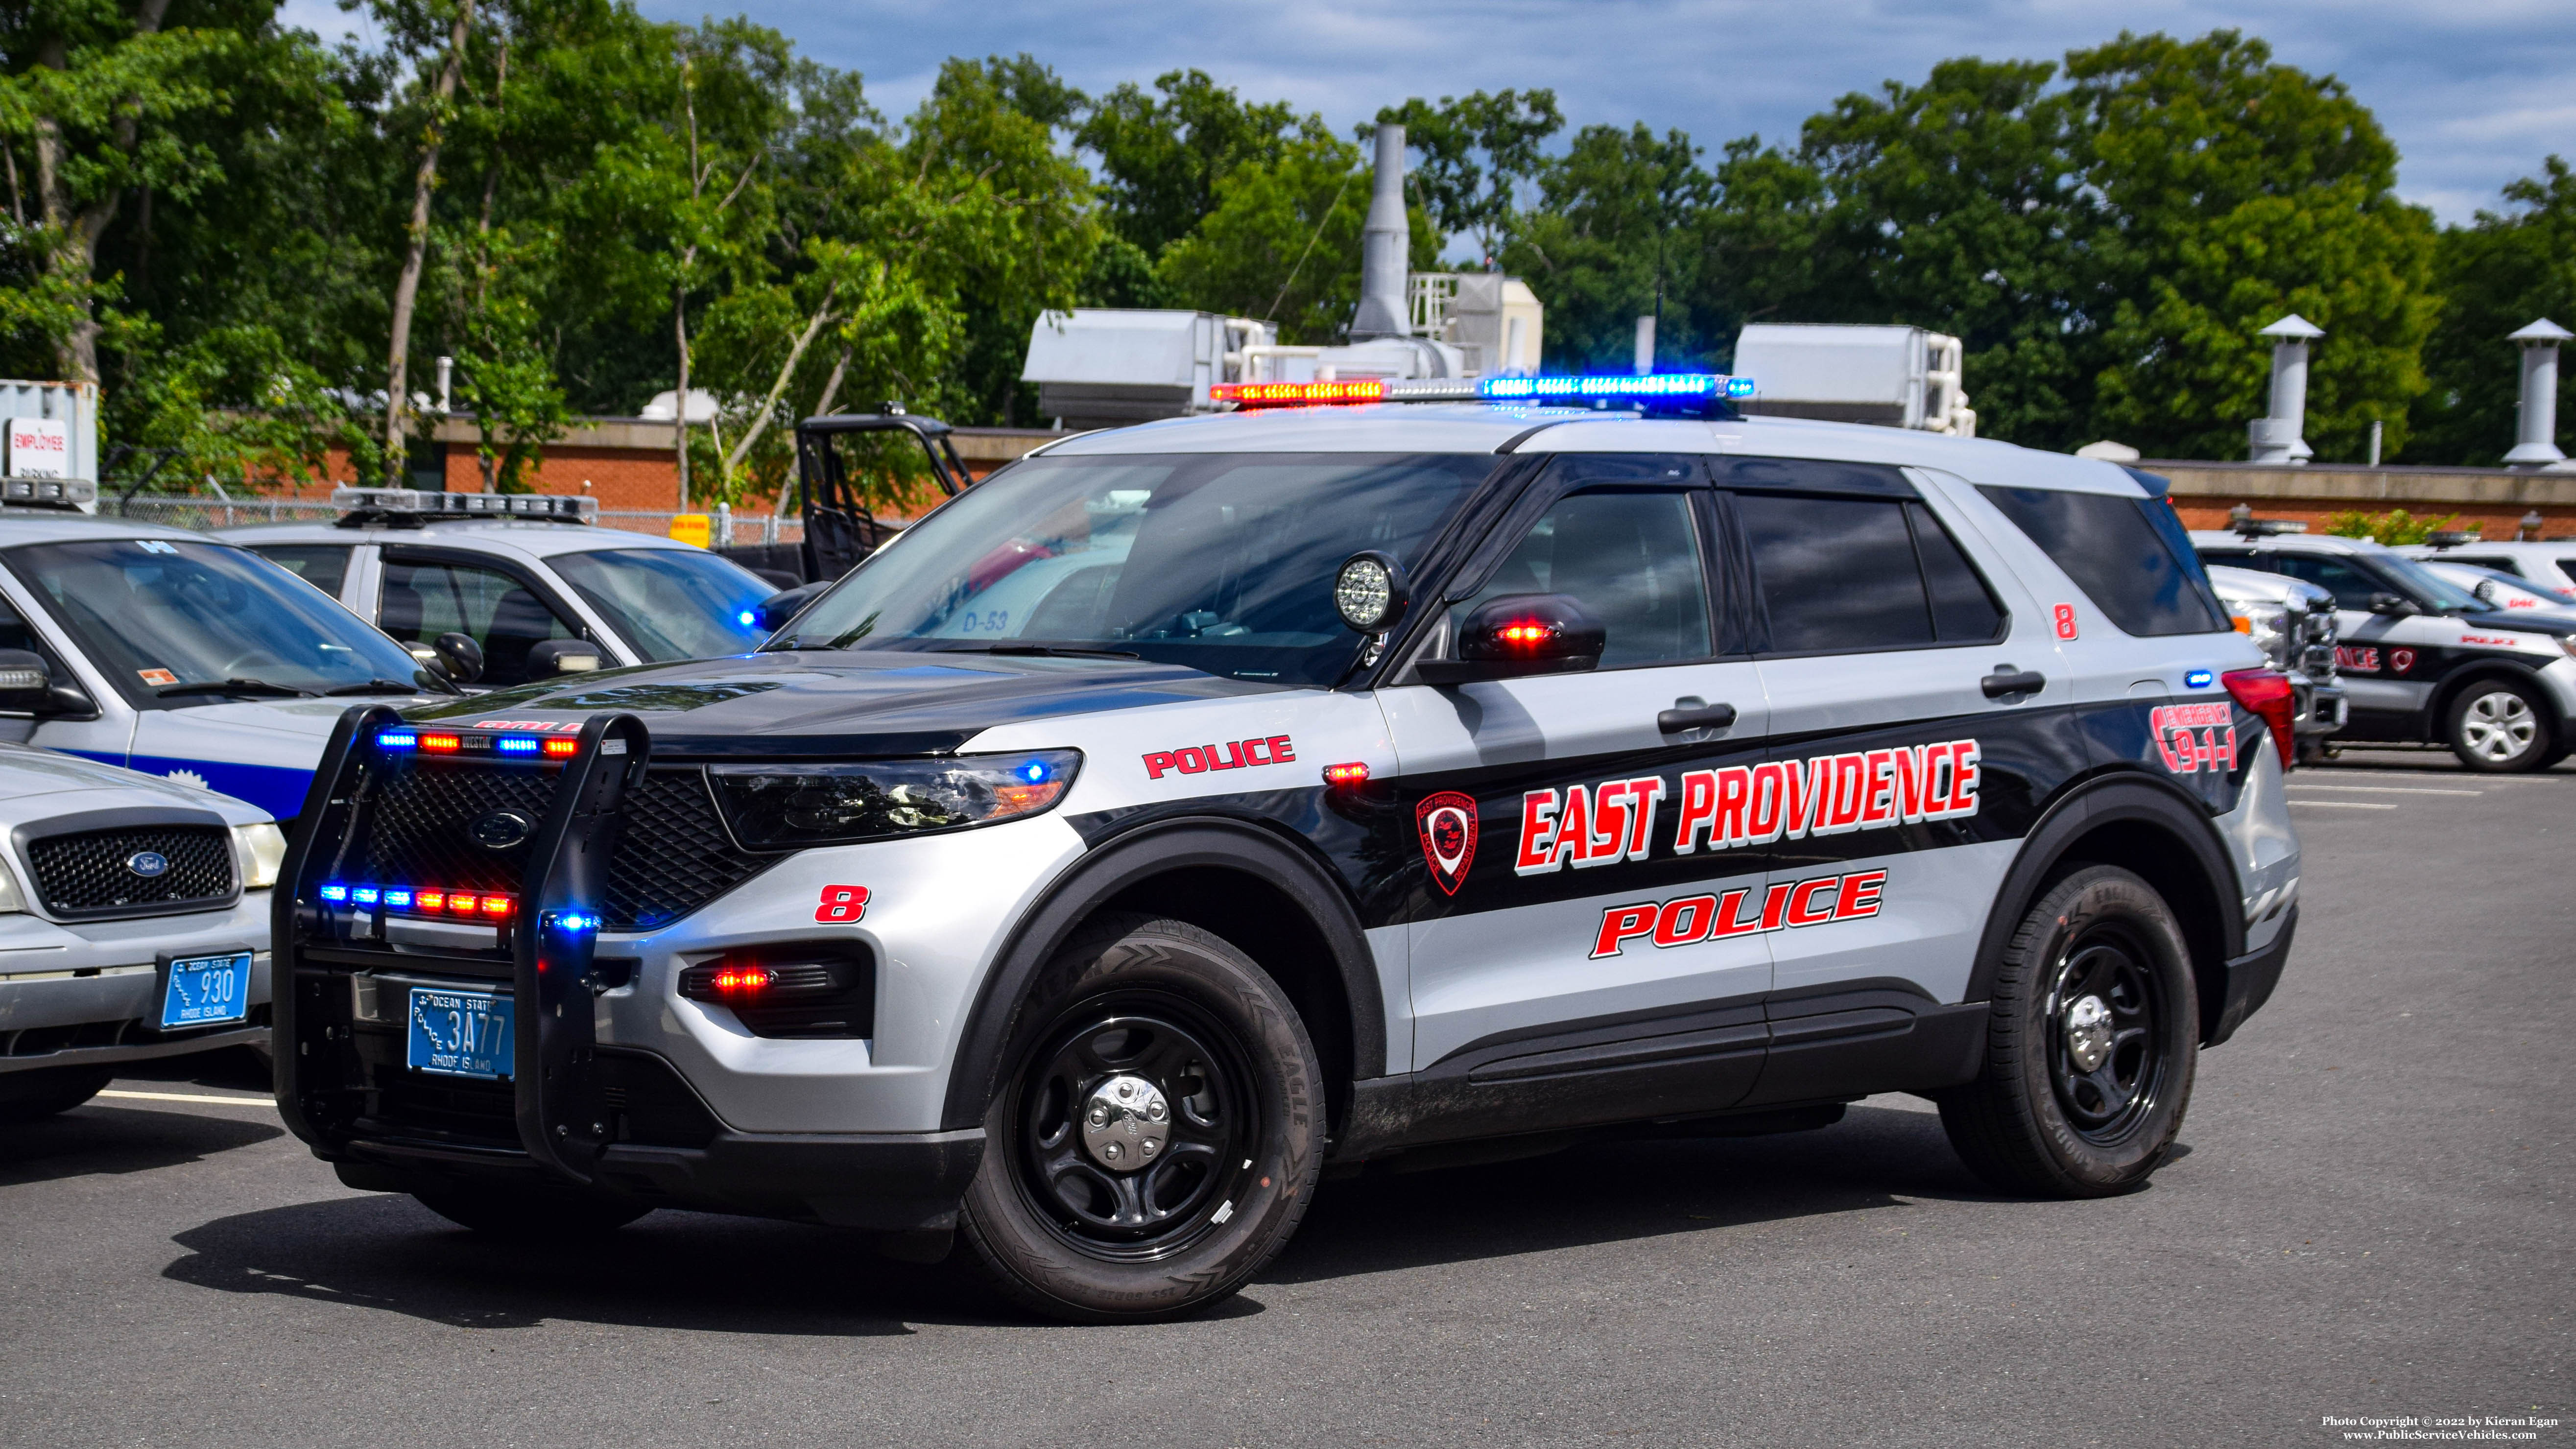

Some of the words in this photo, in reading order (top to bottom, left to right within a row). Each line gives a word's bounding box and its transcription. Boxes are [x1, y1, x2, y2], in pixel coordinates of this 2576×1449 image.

[15, 433, 65, 451] EMPLOYEE
[963, 610, 1009, 632] D-53
[2052, 602, 2079, 641] 8
[2163, 701, 2233, 730] EMERGENCY
[1142, 735, 1296, 780] POLICE
[2173, 725, 2238, 773] 9-1-1
[1419, 800, 1433, 819] EAST
[1435, 795, 1475, 813] PROVIDENCE
[1514, 776, 1665, 877] EAST
[1673, 738, 1981, 855] PROVIDENCE
[1423, 833, 1441, 874] POLICE
[1454, 817, 1476, 881] DEPARTMENT
[813, 883, 872, 925] 8
[1588, 868, 1888, 960] POLICE
[188, 961, 209, 971] OCEAN
[211, 958, 232, 969] STATE
[201, 969, 234, 1003] 930
[433, 996, 460, 1008] OCEAN
[466, 999, 492, 1012] STATE
[181, 1008, 201, 1019] RHODE
[203, 1005, 227, 1017] ISLAND
[414, 1007, 443, 1050] POLICE
[447, 1011, 505, 1055] 3A77
[432, 1054, 458, 1068] RHODE
[462, 1057, 491, 1071] ISLAND
[1278, 1044, 1308, 1128] EAGLE
